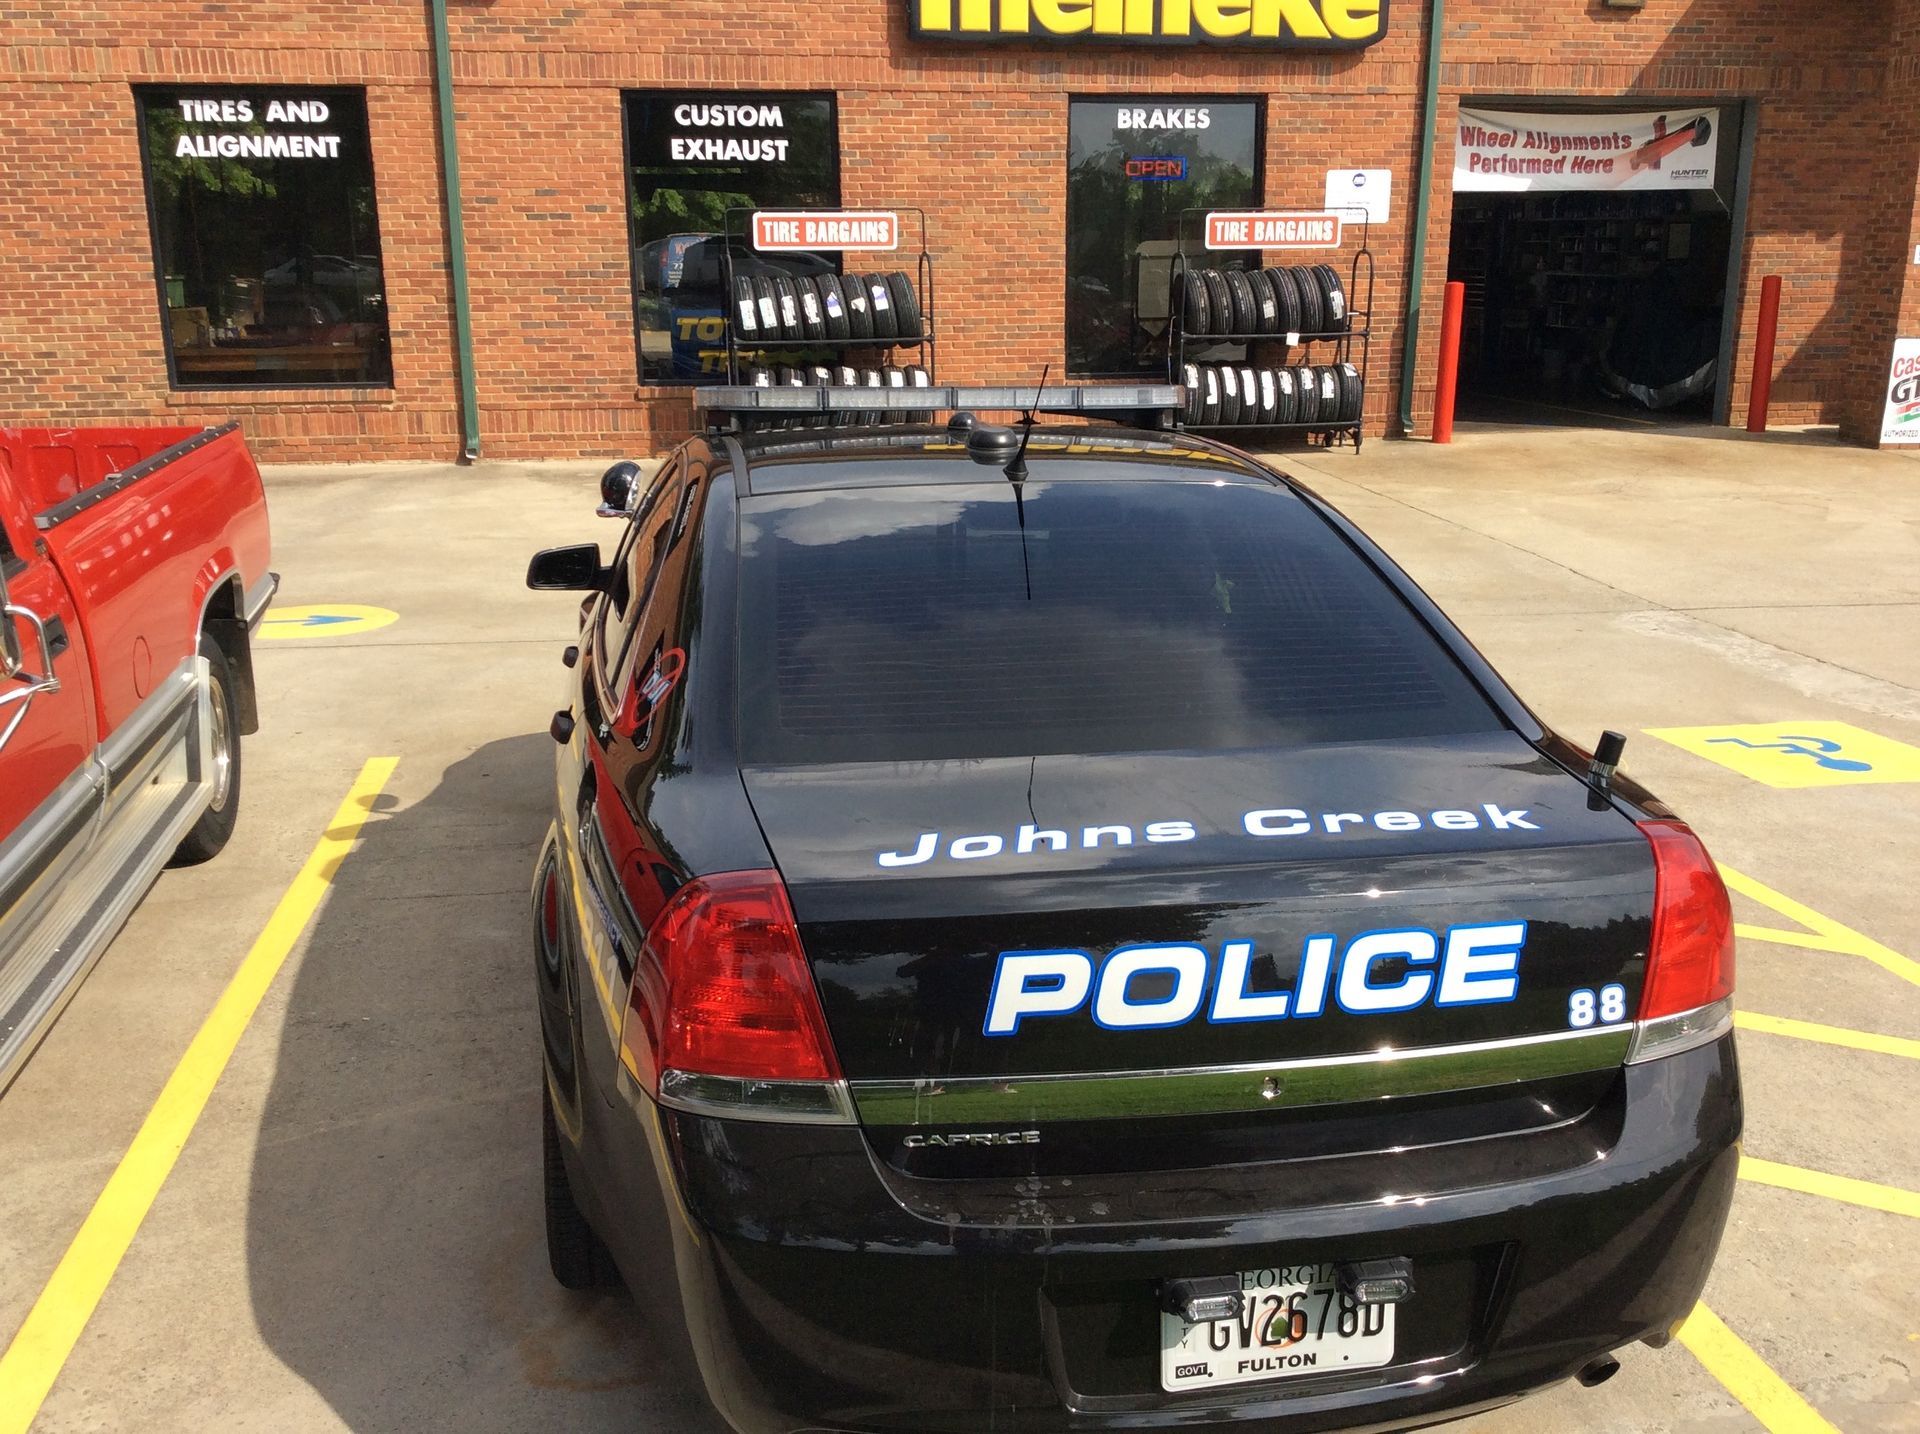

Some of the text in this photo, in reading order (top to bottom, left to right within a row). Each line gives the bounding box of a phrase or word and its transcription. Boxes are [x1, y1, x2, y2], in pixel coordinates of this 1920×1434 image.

[179, 99, 329, 123] TIRES AND
[674, 104, 784, 127] CUSTOM
[1117, 108, 1211, 129] BRAKES
[175, 134, 341, 159] ALIGNMENT
[671, 139, 789, 161] EXHAUST
[1460, 125, 1633, 154] Wheel Alignments
[1125, 160, 1183, 177] OPEN
[1470, 152, 1615, 175] Performed Here
[762, 220, 889, 243] TIRE BARGAINS
[1215, 220, 1333, 242] TIRE BARGAINS
[877, 803, 1541, 868] Johns Creek
[983, 919, 1529, 1037] POLICE
[1568, 982, 1627, 1028] 88
[902, 1130, 1041, 1148] CAPRICE
[1240, 1263, 1337, 1290] EORGIA
[1209, 1286, 1385, 1352] GV2678D
[1176, 1364, 1207, 1378] GOVT
[1237, 1353, 1318, 1374] FULTON
